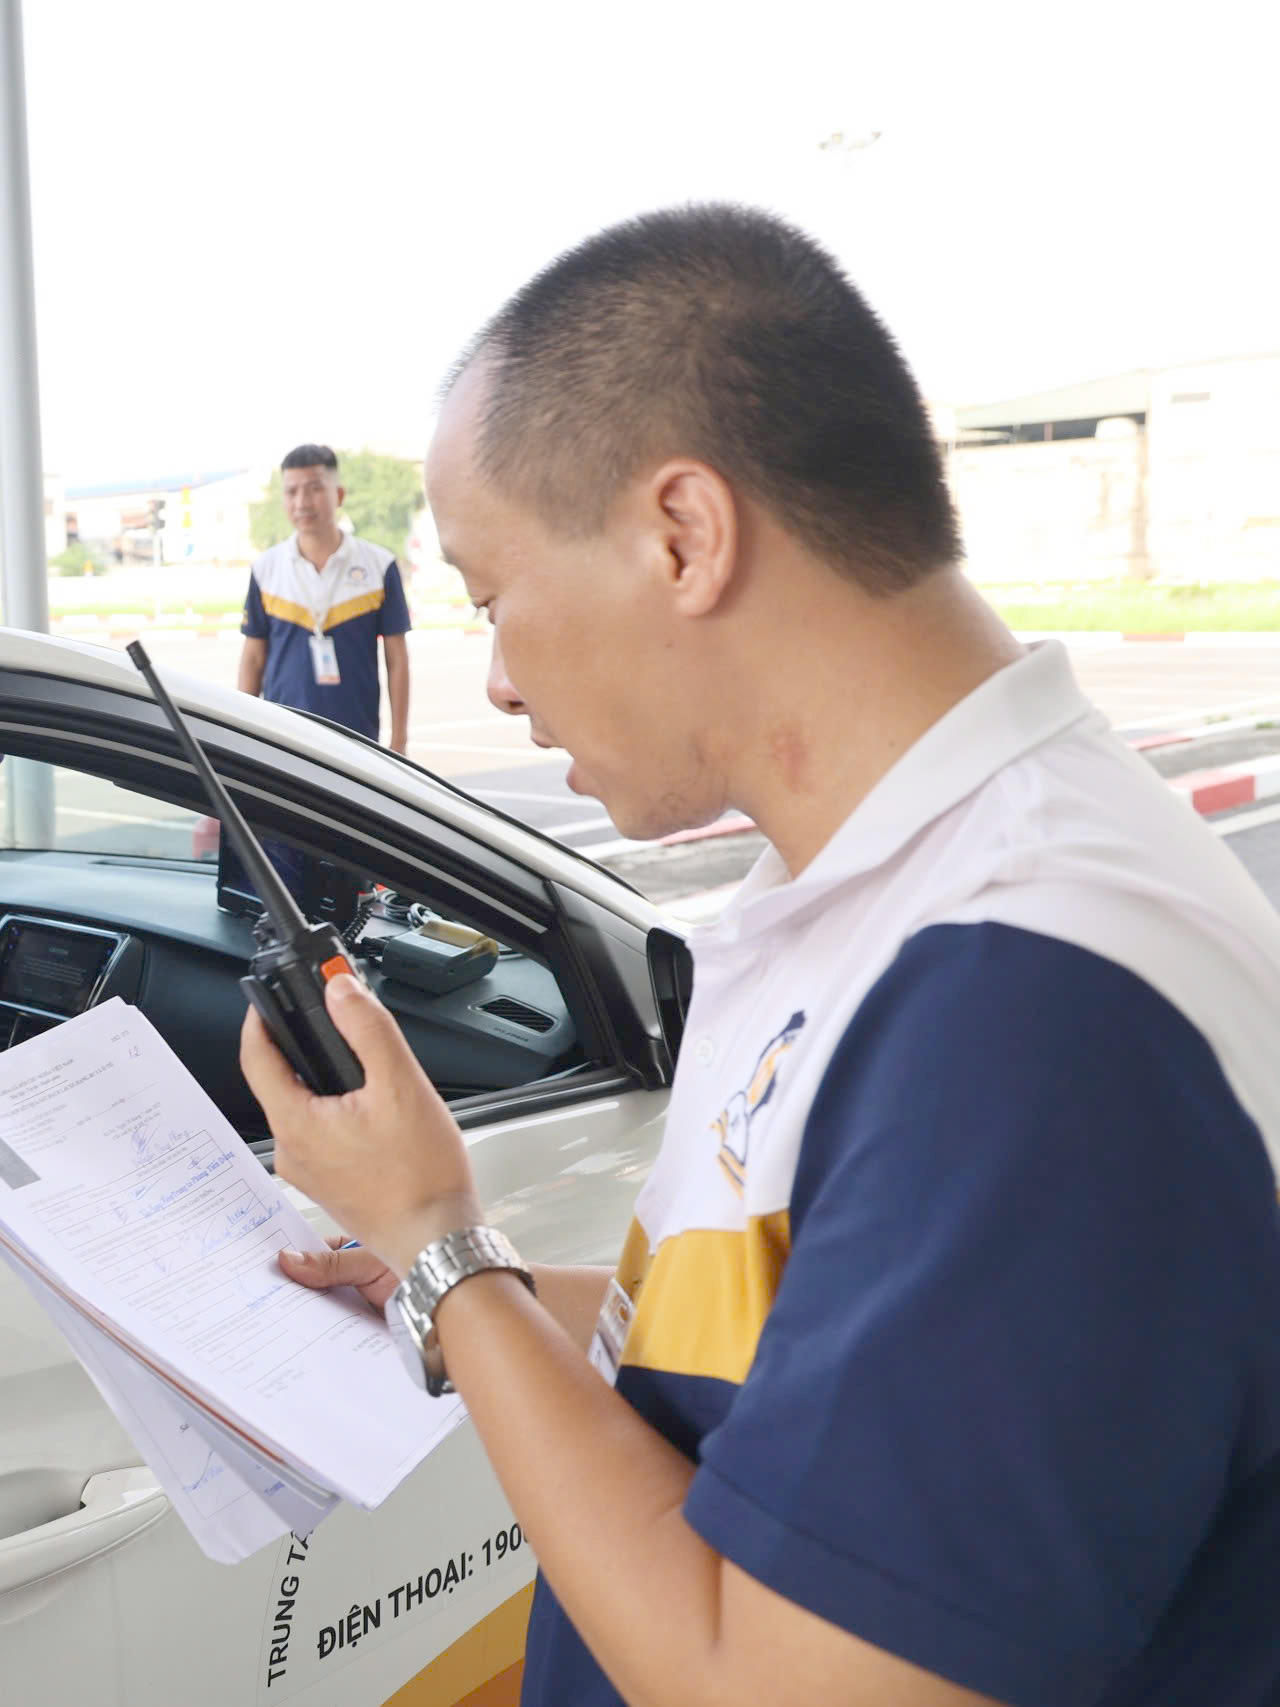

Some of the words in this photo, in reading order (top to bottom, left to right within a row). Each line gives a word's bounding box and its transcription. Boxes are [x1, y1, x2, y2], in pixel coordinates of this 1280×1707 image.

[267, 1575, 300, 1687] TRUNG
[316, 1599, 381, 1660] ĐIỆN
[387, 1552, 473, 1618] THOẠI:
[482, 1522, 528, 1566] 190
